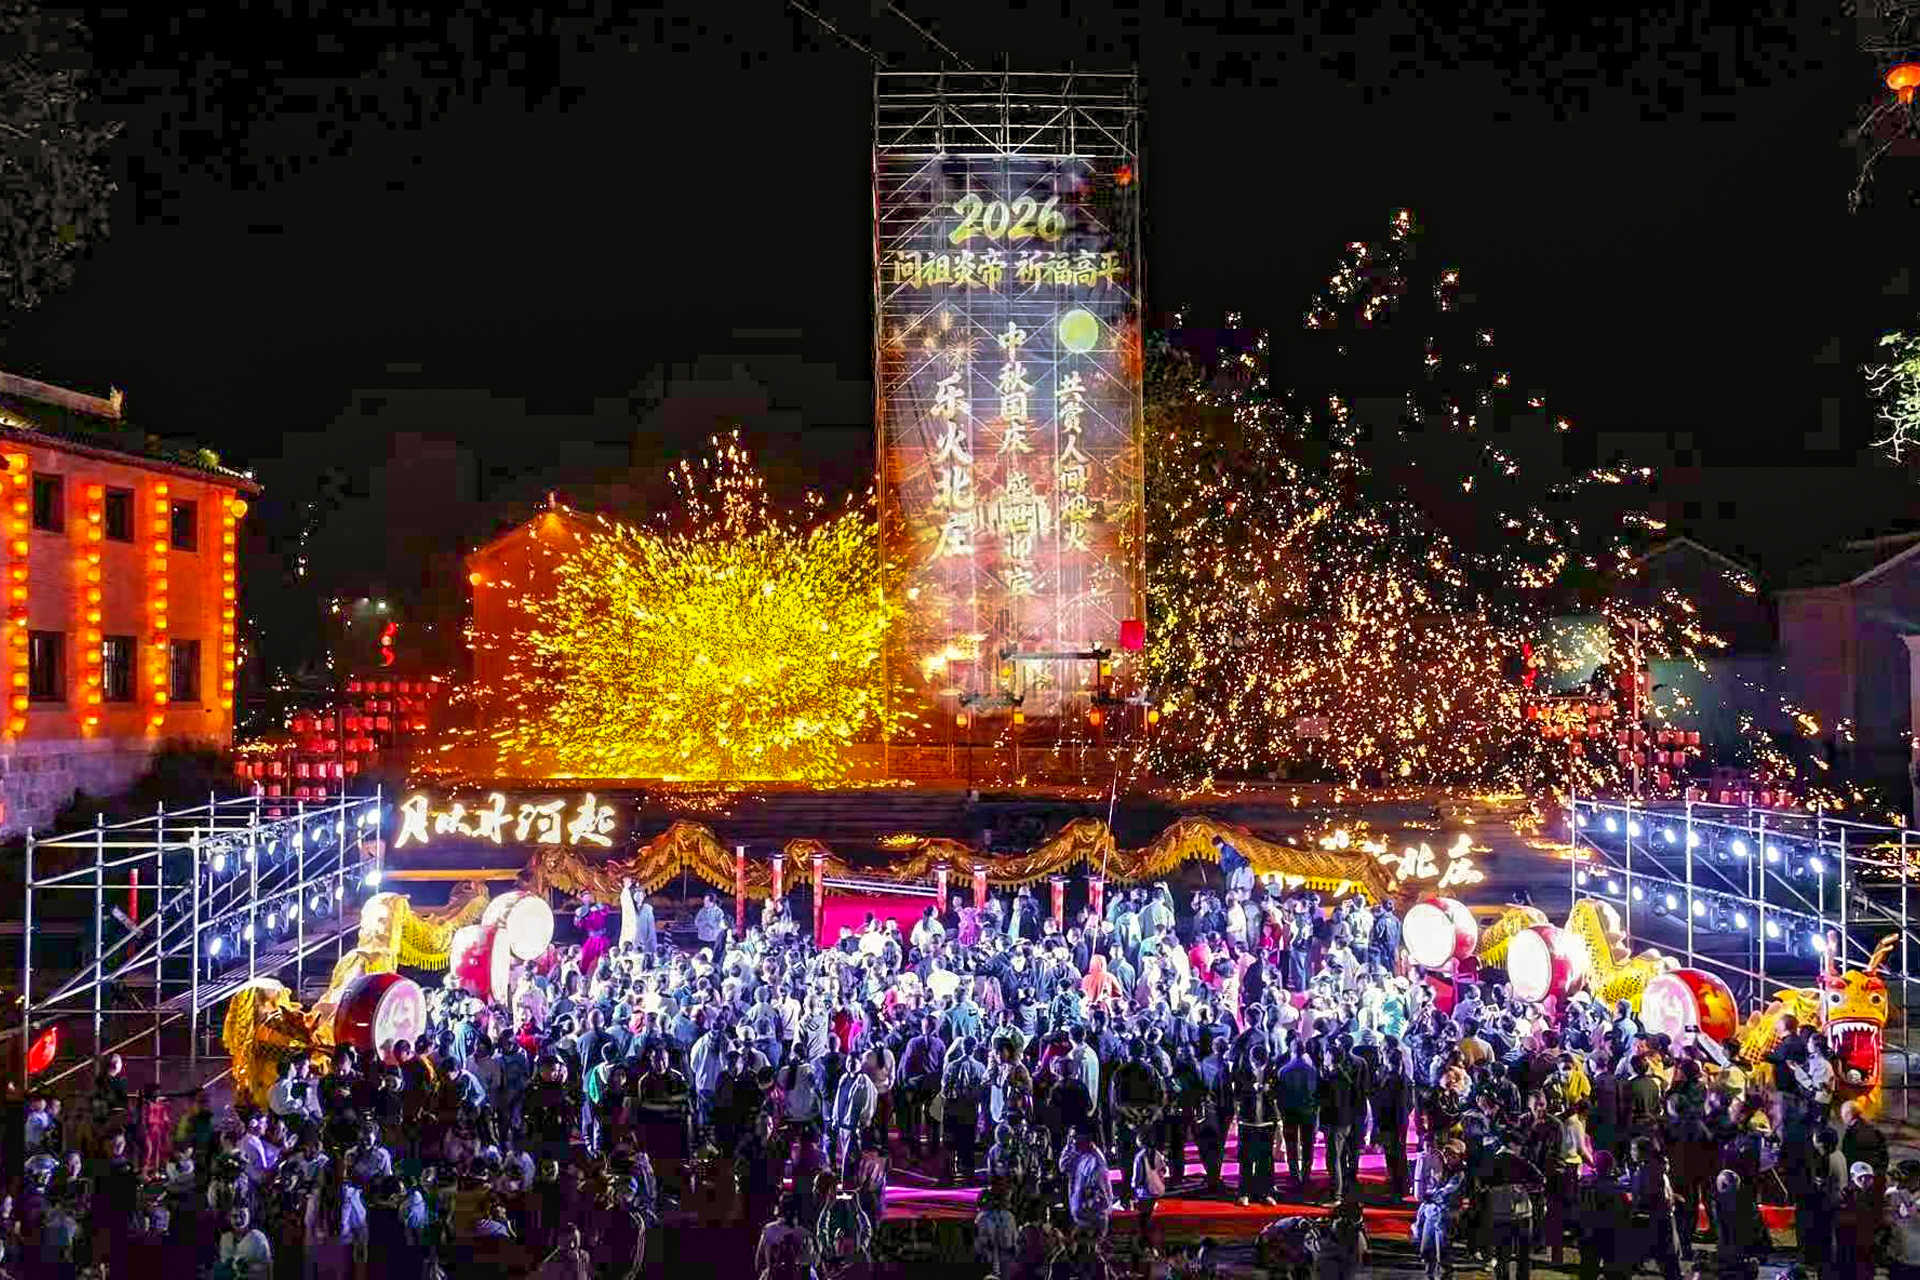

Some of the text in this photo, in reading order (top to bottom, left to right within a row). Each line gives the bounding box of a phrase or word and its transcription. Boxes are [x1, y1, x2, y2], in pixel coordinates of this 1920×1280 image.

[949, 193, 1066, 244] 2026
[893, 248, 1125, 293] 问祖炎帝 祈福高平
[997, 321, 1035, 454] 中秋国庆
